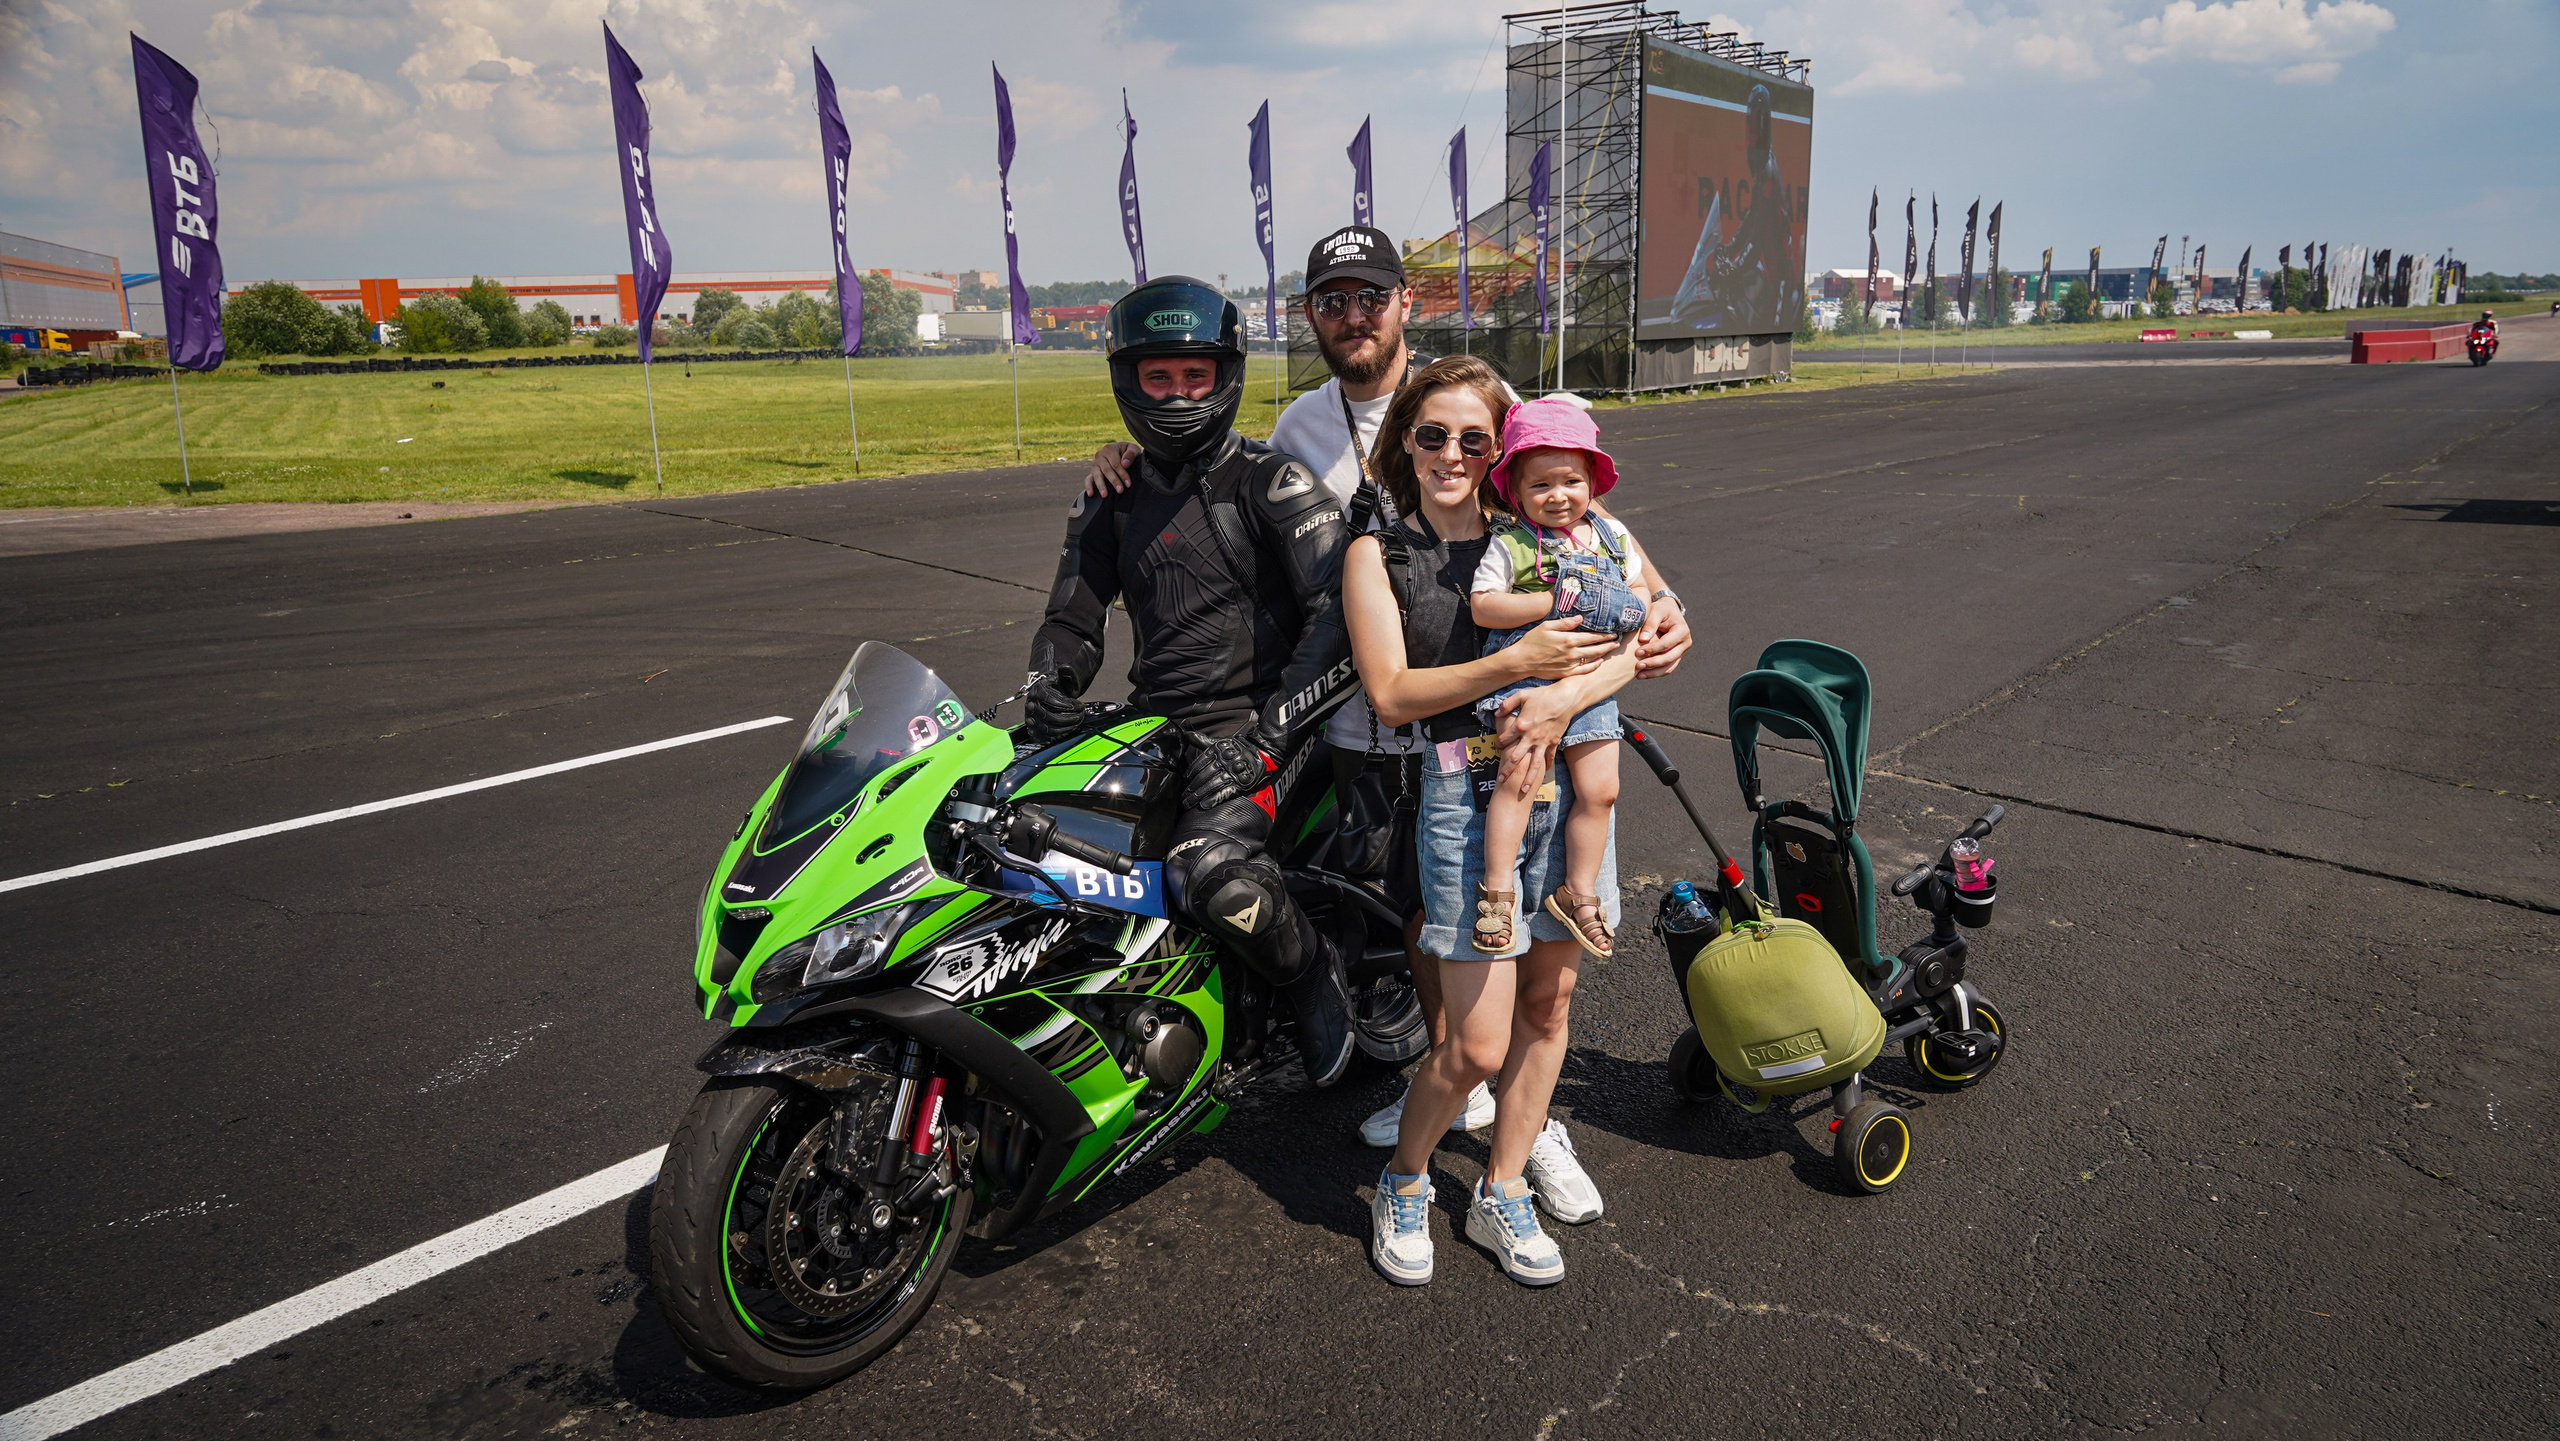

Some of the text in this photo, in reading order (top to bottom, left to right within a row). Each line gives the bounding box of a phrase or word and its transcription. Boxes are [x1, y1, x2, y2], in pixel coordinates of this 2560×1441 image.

[167, 151, 210, 241] ВТБ
[1323, 231, 1374, 255] INDIANA
[1329, 254, 1367, 265] ATHLETICS
[1152, 314, 1193, 327] SHOEI
[1623, 609, 1640, 622] 1969
[1278, 656, 1357, 726] DAINES
[1075, 867, 1144, 899] ВТБ
[946, 956, 973, 978] 26
[973, 918, 1071, 998] Ninja
[1748, 1033, 1824, 1064] STOKKE
[928, 1095, 944, 1136] SHOWA
[1113, 1088, 1208, 1177] Kawasaki
